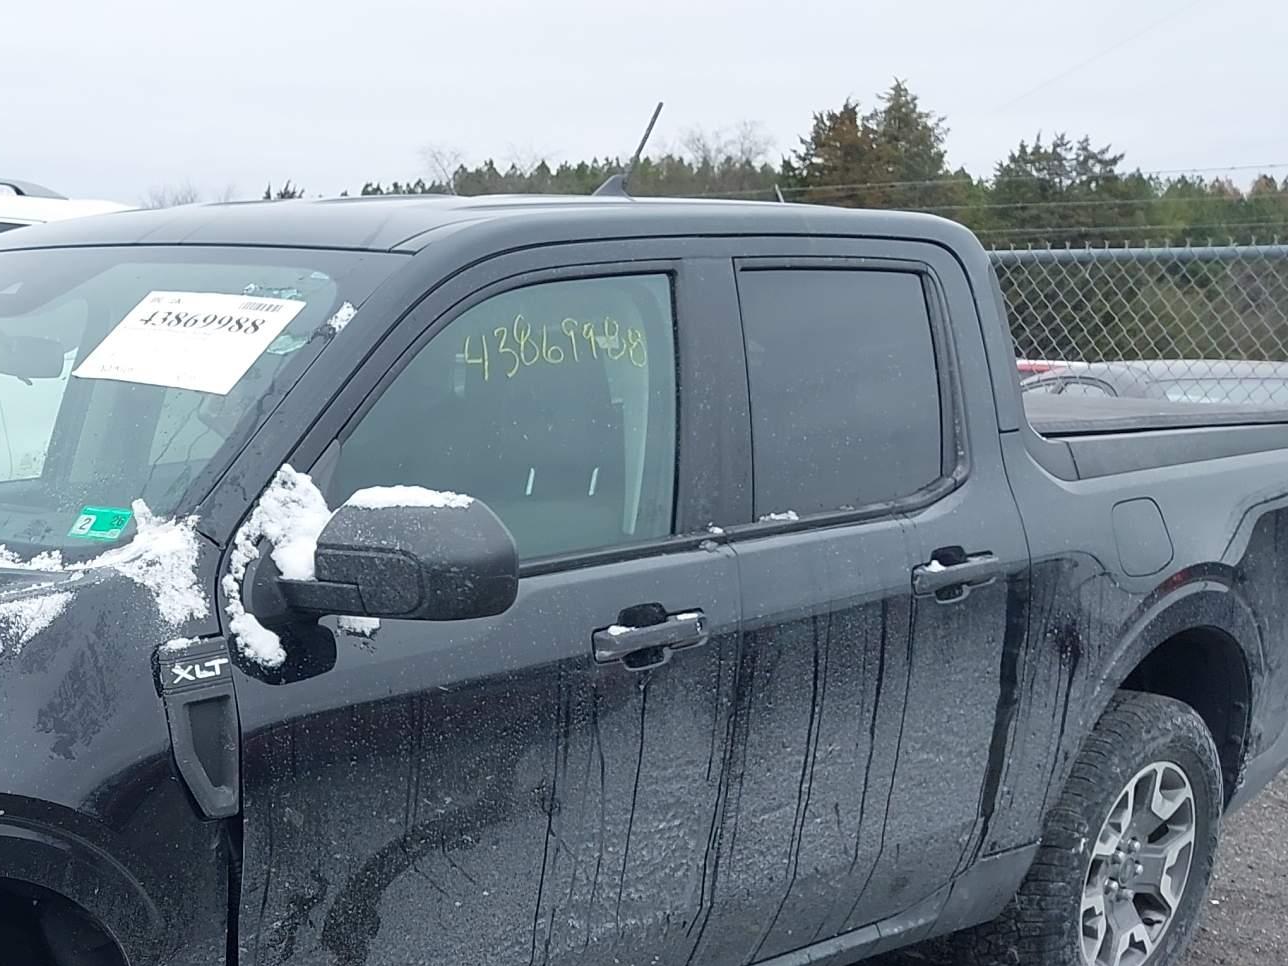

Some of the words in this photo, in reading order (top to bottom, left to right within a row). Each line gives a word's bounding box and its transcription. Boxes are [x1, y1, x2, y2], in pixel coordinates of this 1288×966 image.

[140, 310, 266, 336] 43869988
[464, 314, 648, 381] 43869988
[171, 658, 229, 684] XLT
